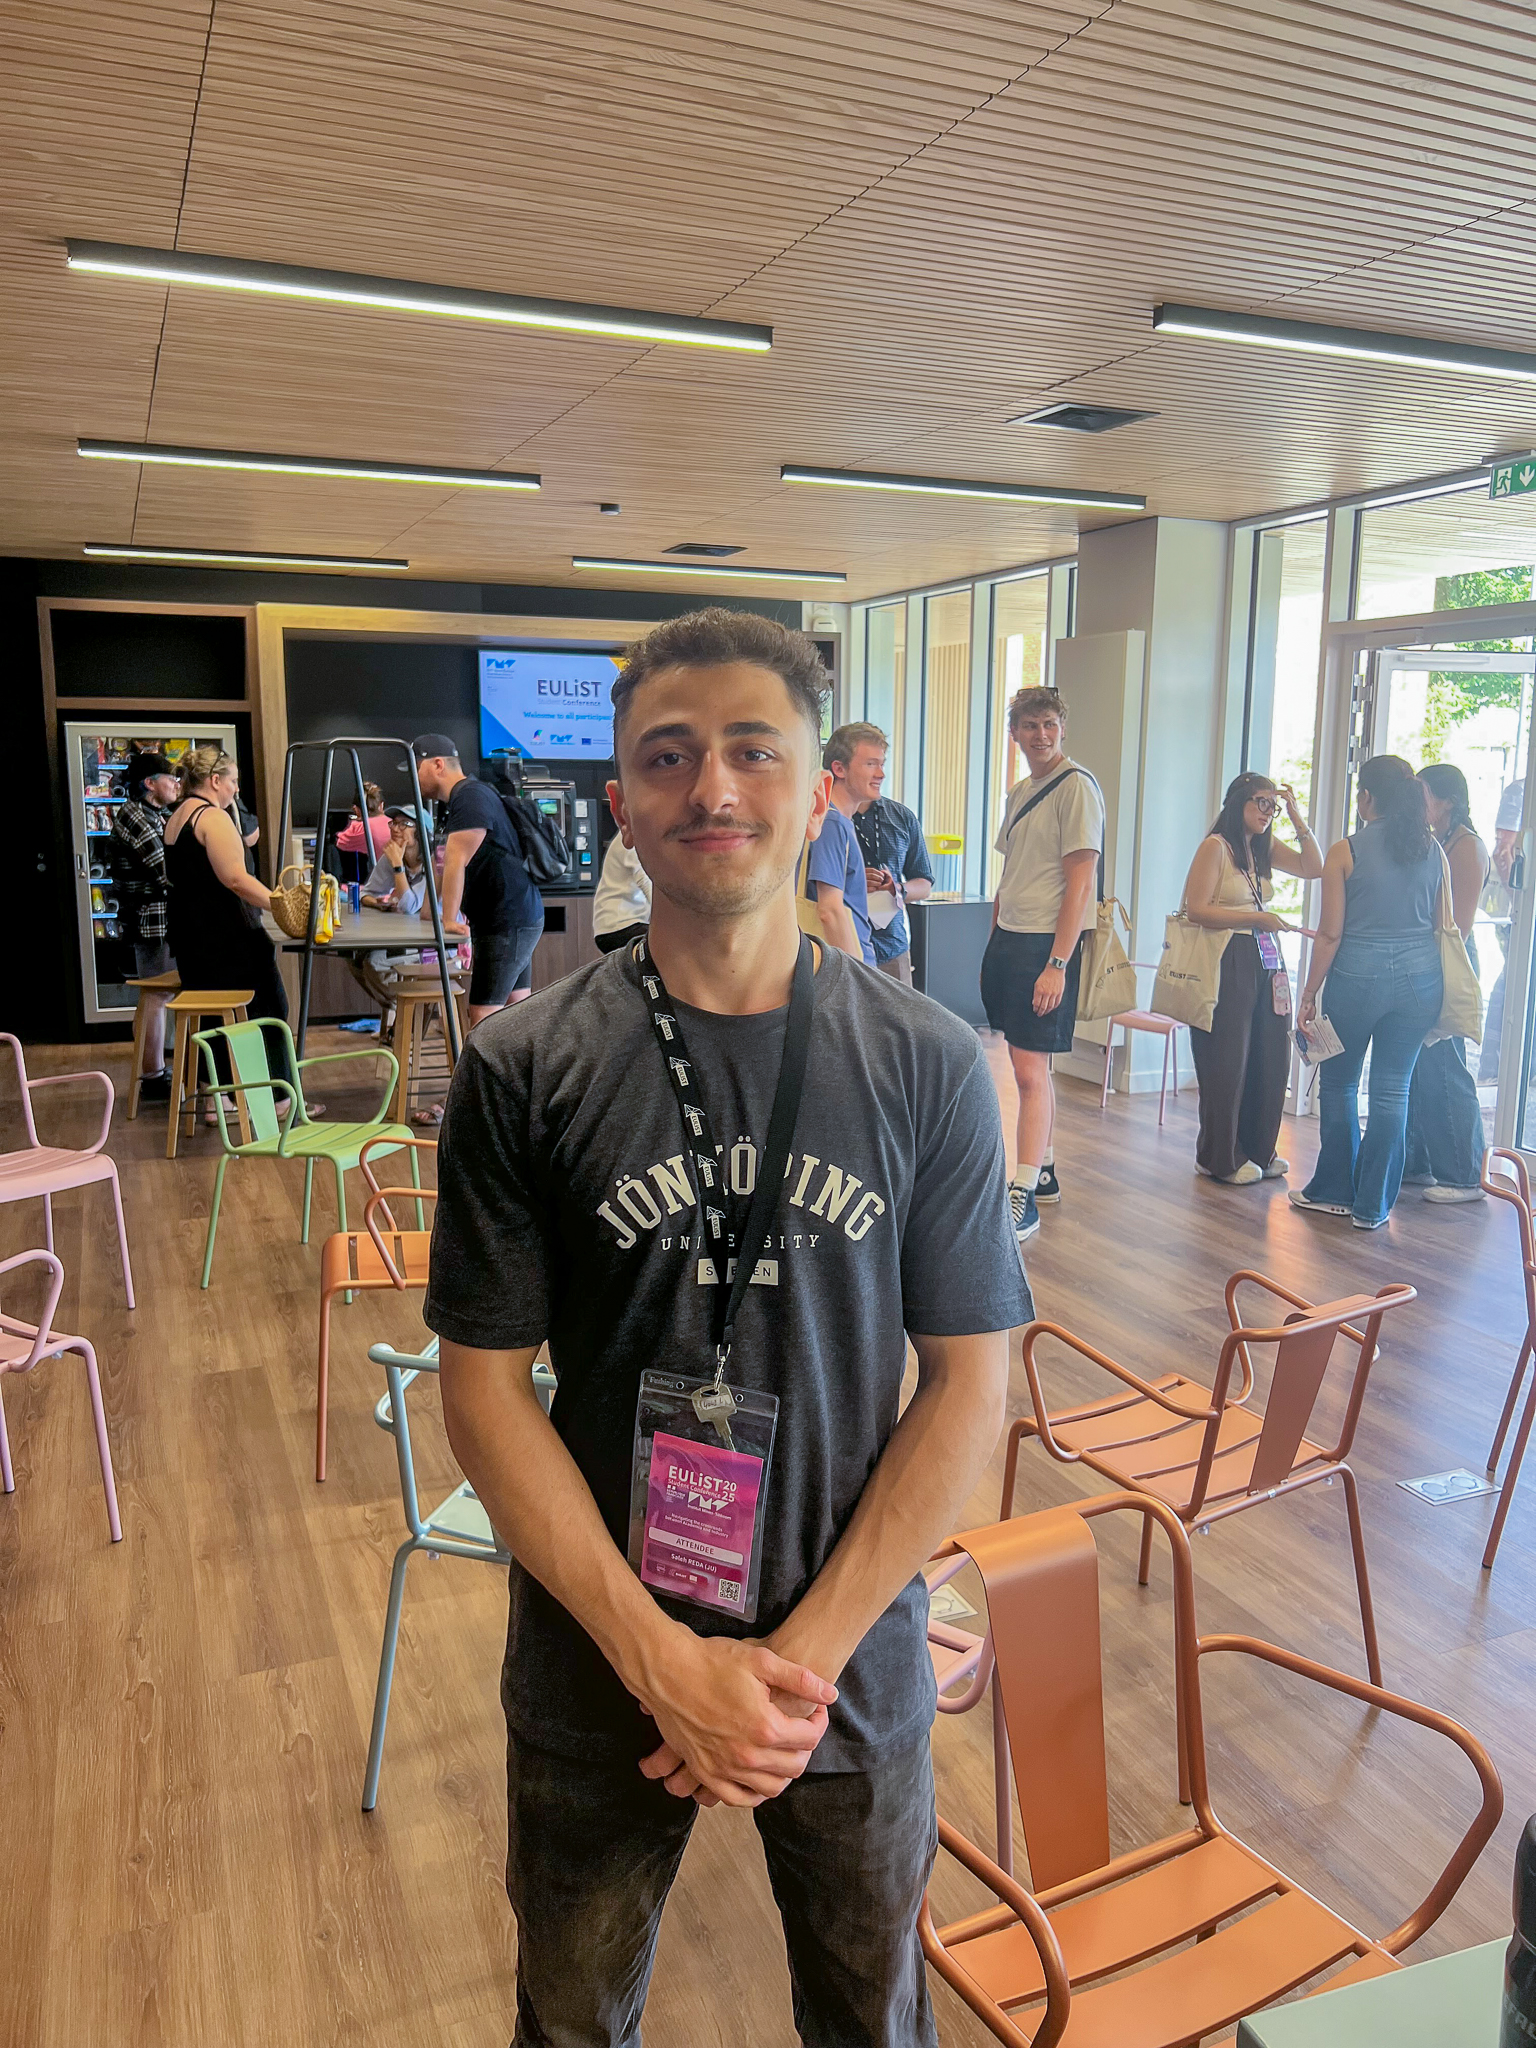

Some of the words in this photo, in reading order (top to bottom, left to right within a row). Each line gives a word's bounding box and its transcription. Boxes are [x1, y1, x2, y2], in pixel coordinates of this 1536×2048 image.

[537, 679, 602, 697] EULiST
[596, 1135, 885, 1249] JÖNÖING
[706, 1266, 770, 1276] SEEN
[668, 1465, 723, 1492] EULiST
[723, 1480, 737, 1492] 20
[668, 1478, 689, 1490] Student
[690, 1485, 721, 1499] Conference
[722, 1491, 735, 1502] 25
[676, 1538, 715, 1555] ATTENDEE
[687, 1558, 704, 1569] REDA
[704, 1563, 717, 1573] (JU)
